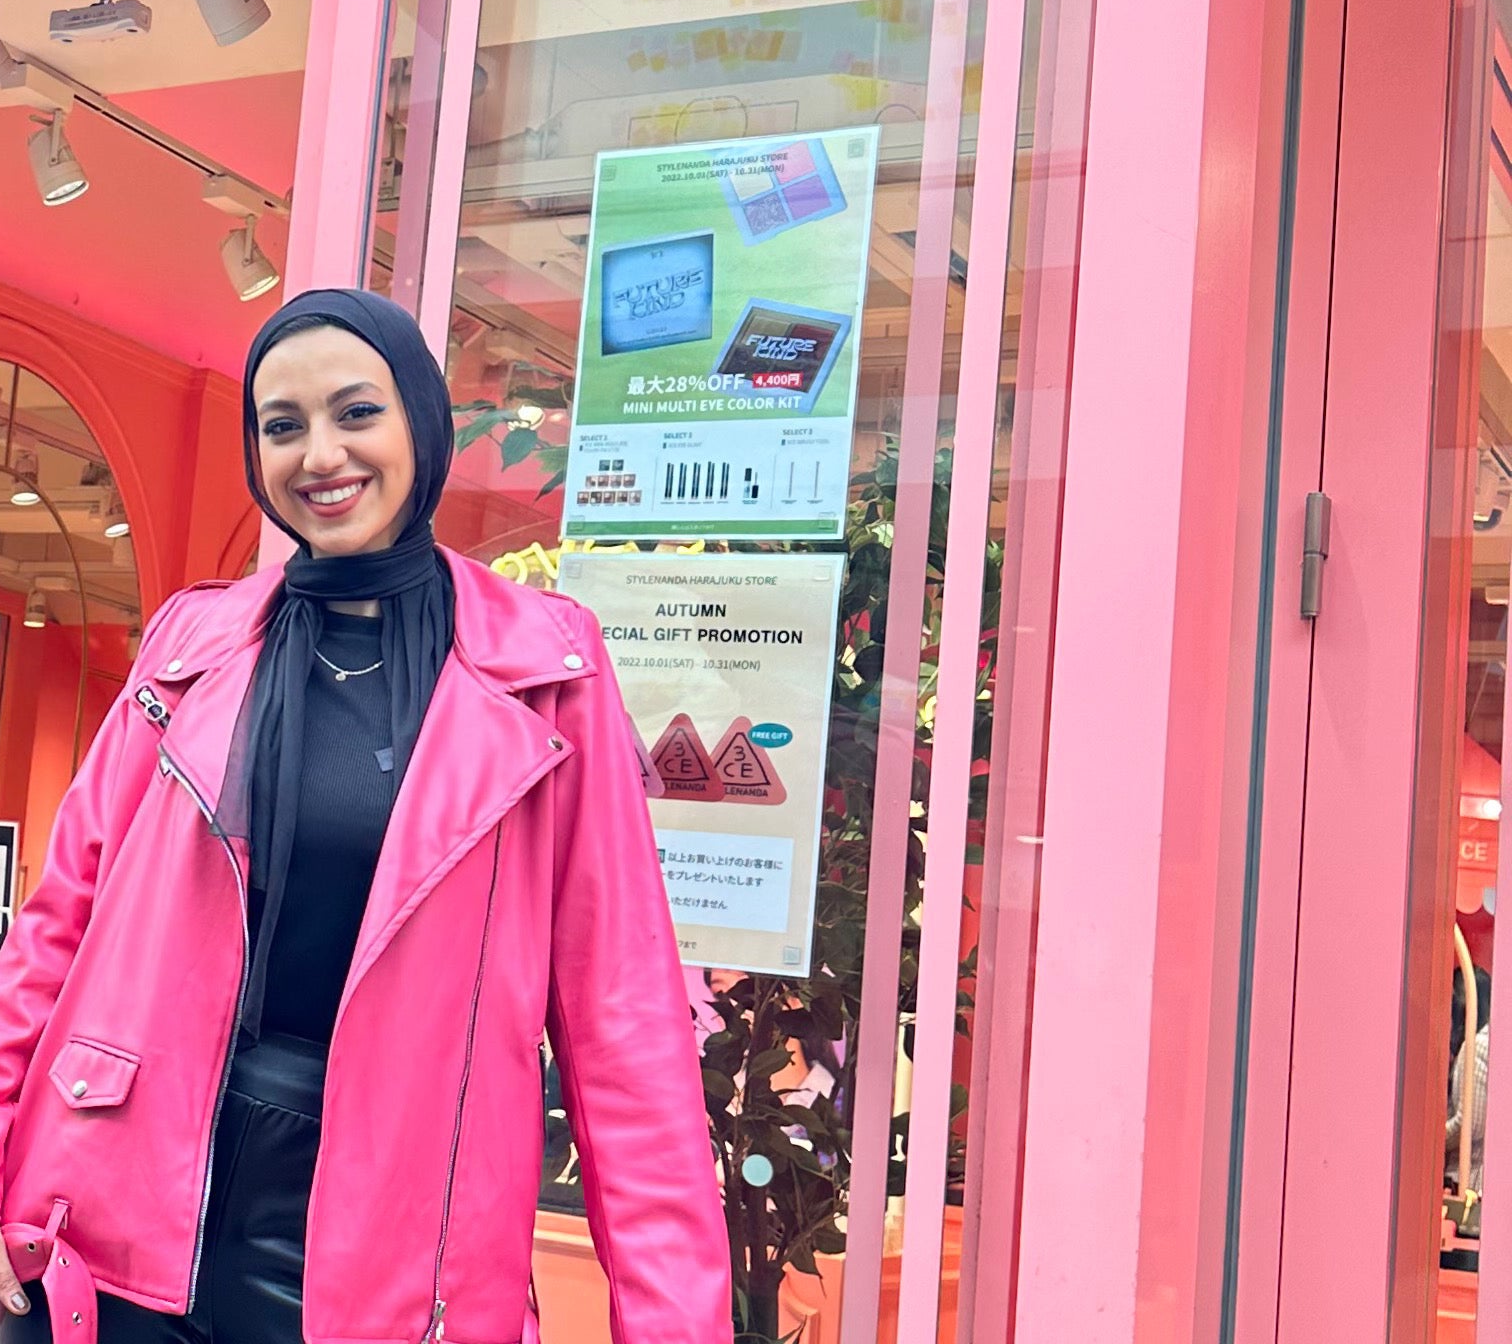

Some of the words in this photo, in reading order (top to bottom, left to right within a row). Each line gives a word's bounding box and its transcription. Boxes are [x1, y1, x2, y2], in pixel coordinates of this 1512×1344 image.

[657, 160, 710, 172] STYLENANDA
[745, 333, 818, 353] FUTURE
[627, 373, 746, 395] 最大28%OFF
[623, 401, 653, 415] MINI
[656, 399, 696, 413] MULTI
[700, 398, 723, 412] EYE
[727, 397, 777, 411] COLOR
[778, 396, 802, 409] KIT
[626, 575, 687, 585] STYLENANDA
[689, 576, 742, 586] HARAJUKU
[744, 576, 778, 586] STORE
[655, 603, 726, 617] AUTUMN
[653, 627, 692, 642] GIFT
[697, 628, 803, 644] PROMOTION
[751, 731, 770, 740] FREE
[771, 731, 788, 740] GIFT
